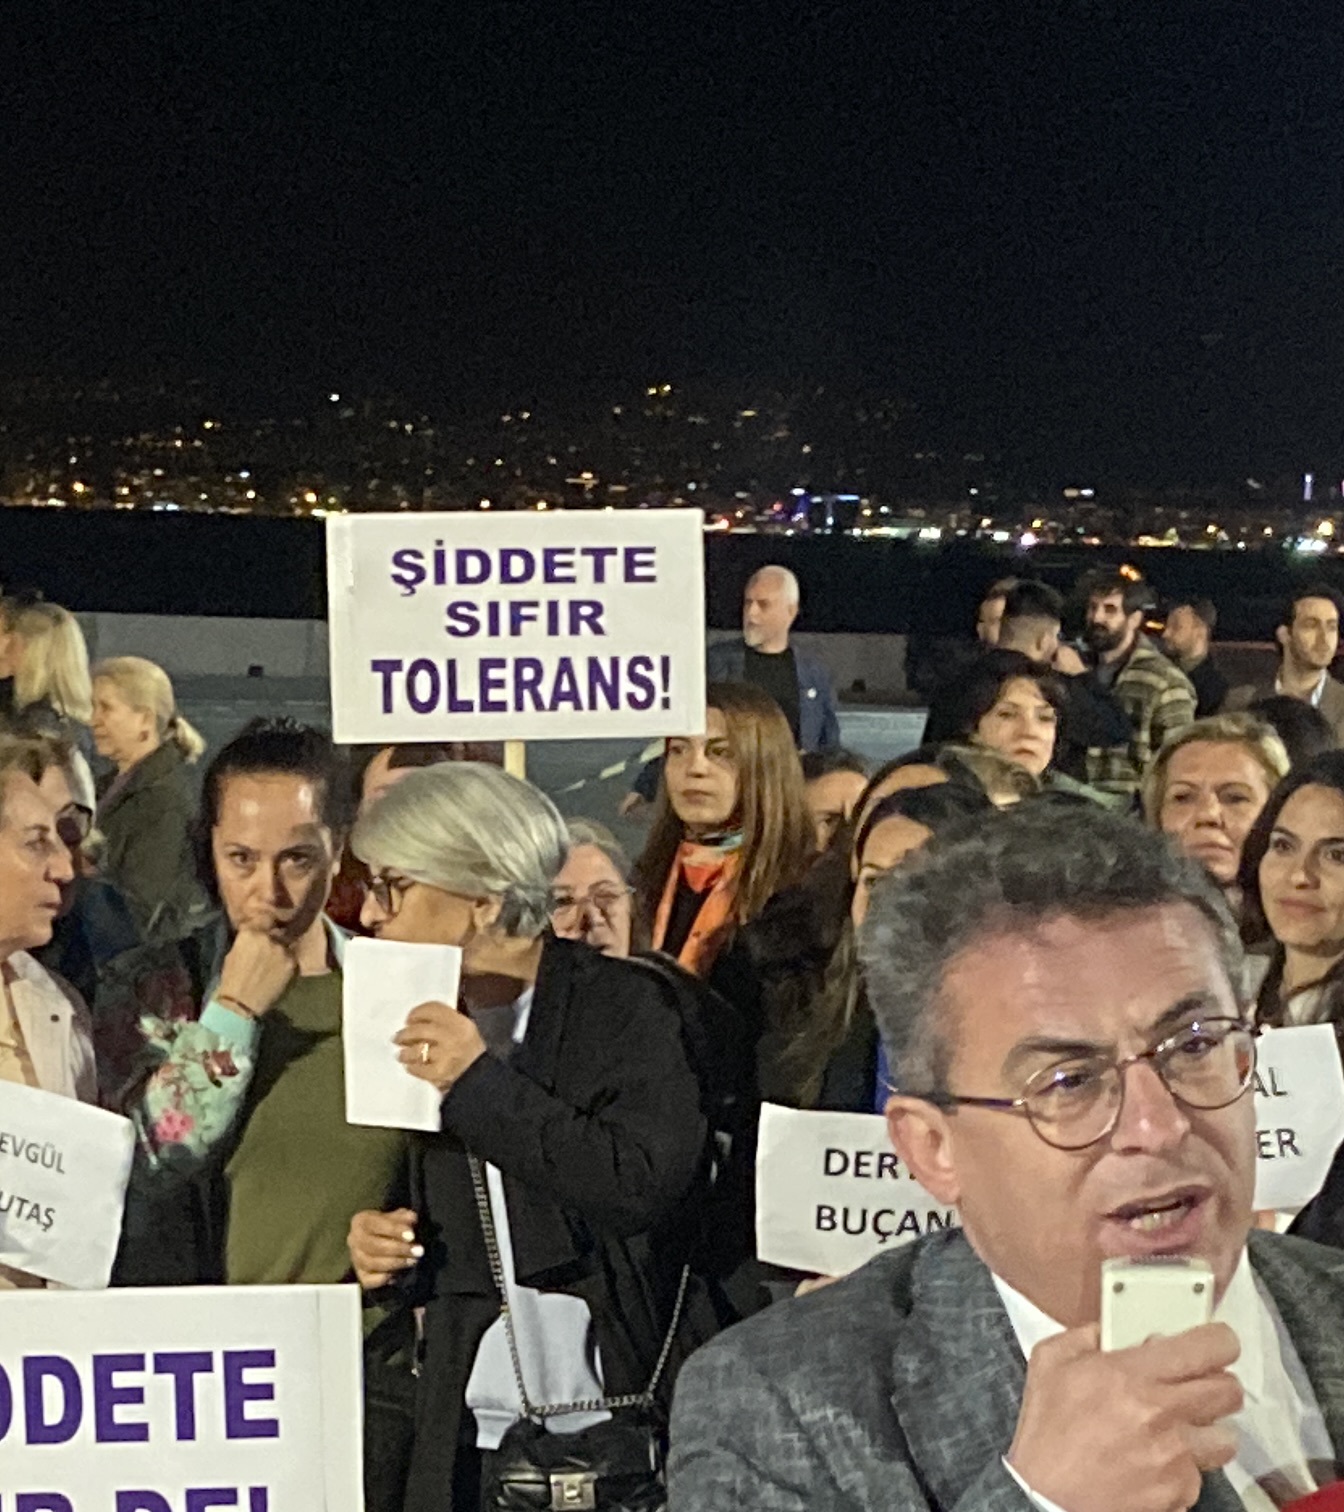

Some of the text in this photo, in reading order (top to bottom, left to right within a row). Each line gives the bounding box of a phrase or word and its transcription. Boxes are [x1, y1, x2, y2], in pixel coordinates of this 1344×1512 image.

[391, 539, 657, 597] ŞİDDETE
[445, 600, 606, 637] SIFIR
[371, 655, 672, 714] TOLERANS!
[823, 1147, 916, 1181] DER
